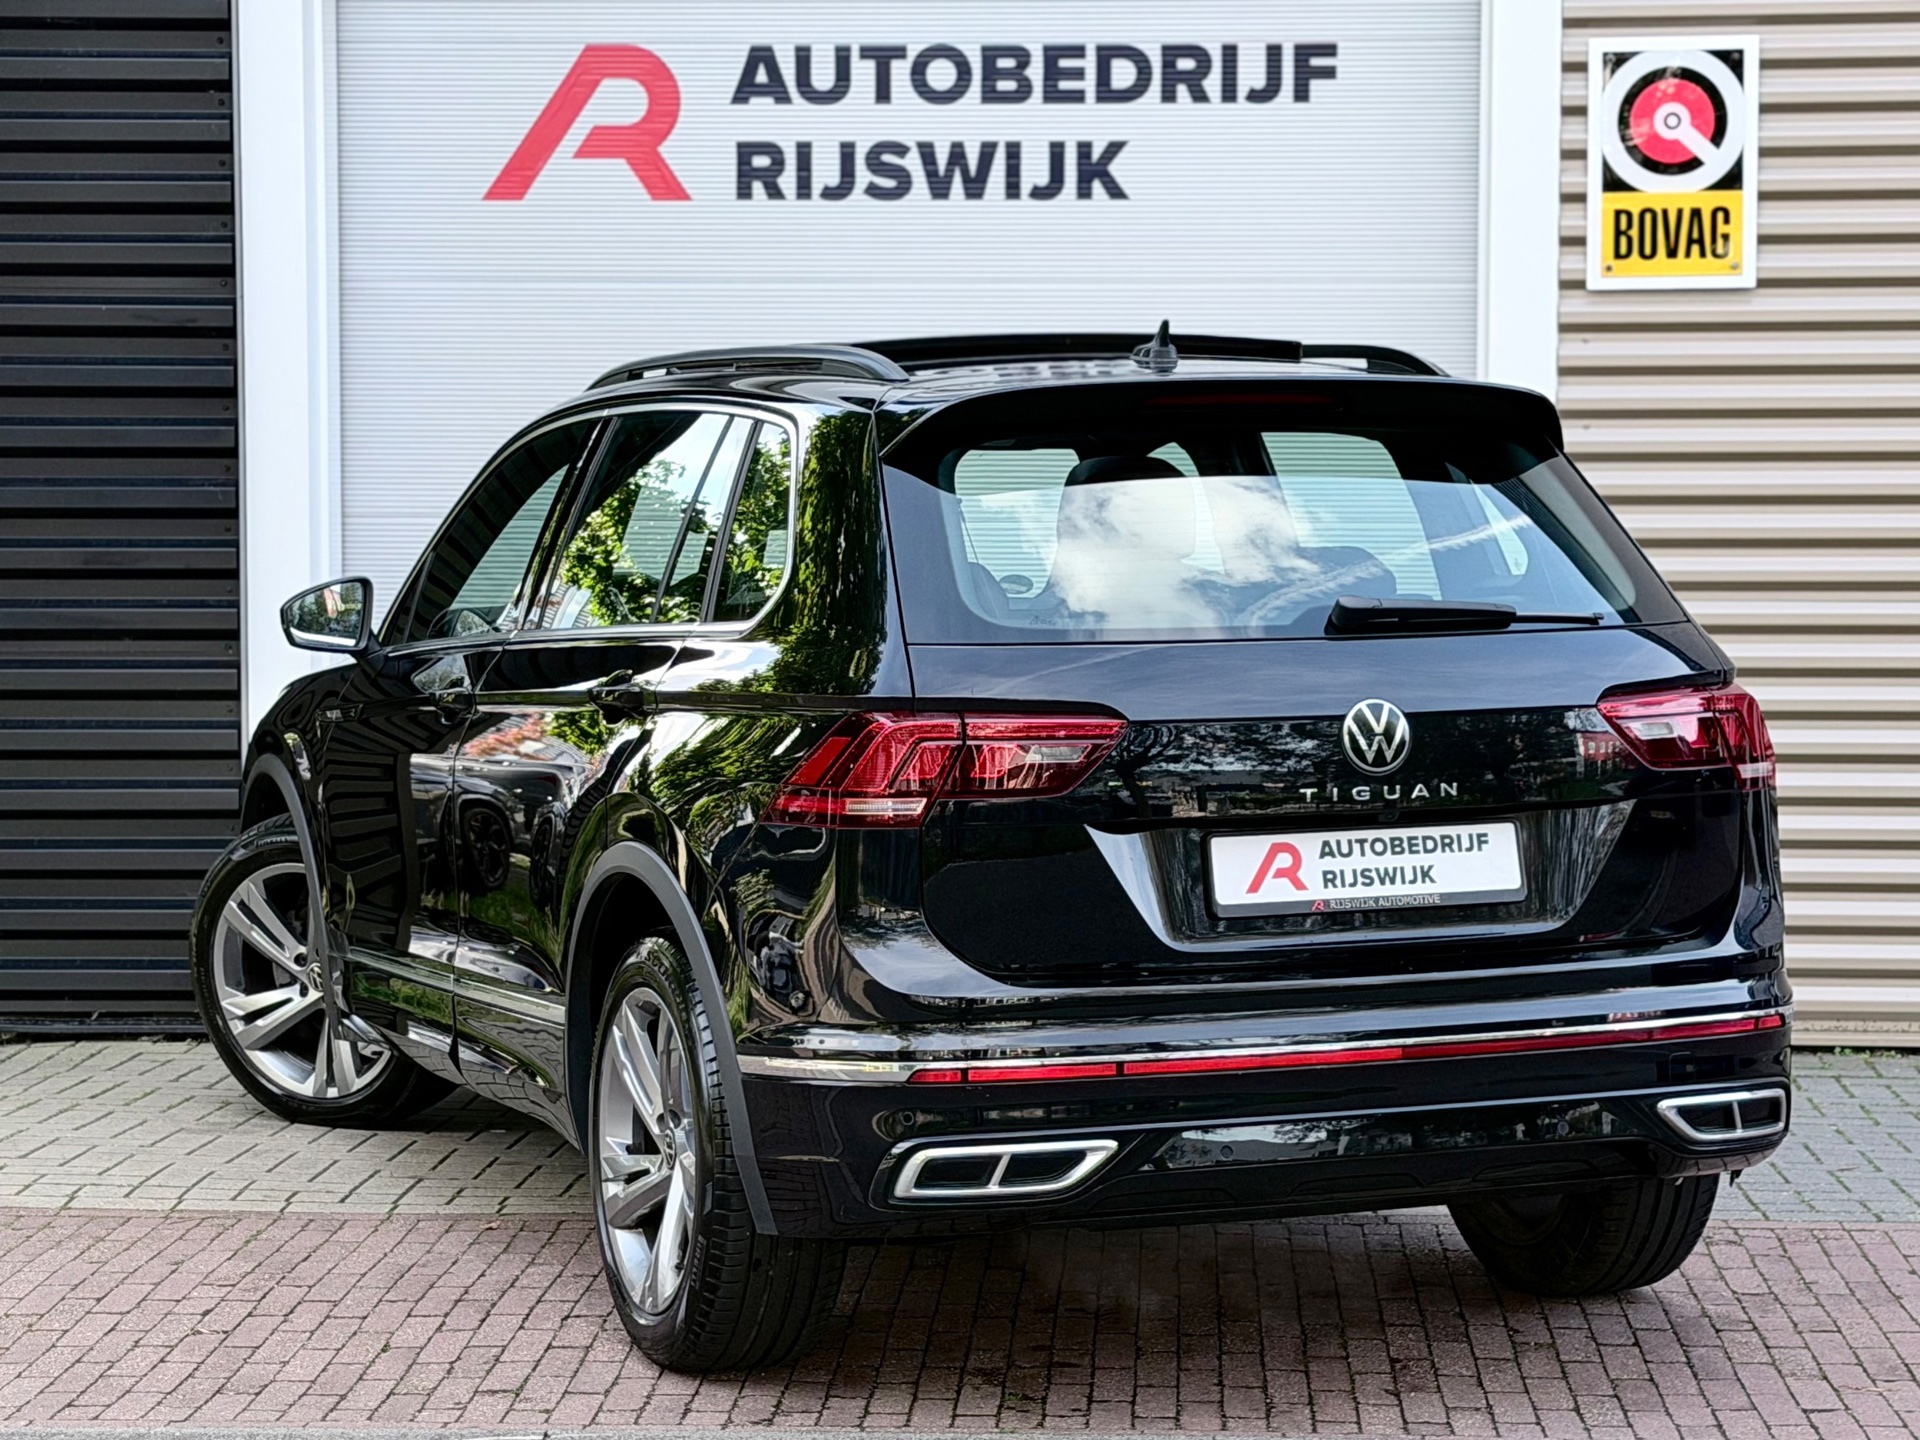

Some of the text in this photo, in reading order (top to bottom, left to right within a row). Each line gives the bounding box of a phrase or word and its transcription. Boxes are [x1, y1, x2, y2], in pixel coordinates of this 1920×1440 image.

[730, 43, 1338, 105] AUTOBEDRIJF
[735, 140, 1130, 201] RIJSWIJK
[1613, 206, 1731, 260] BOVAG
[1299, 782, 1458, 803] TIGUAN
[1318, 832, 1490, 860] AUTOBEDRIJF
[1321, 864, 1437, 890] RIJSWIJK
[1329, 898, 1376, 909] RIJSWIJK
[1378, 894, 1441, 906] AUTOMOTIVE
